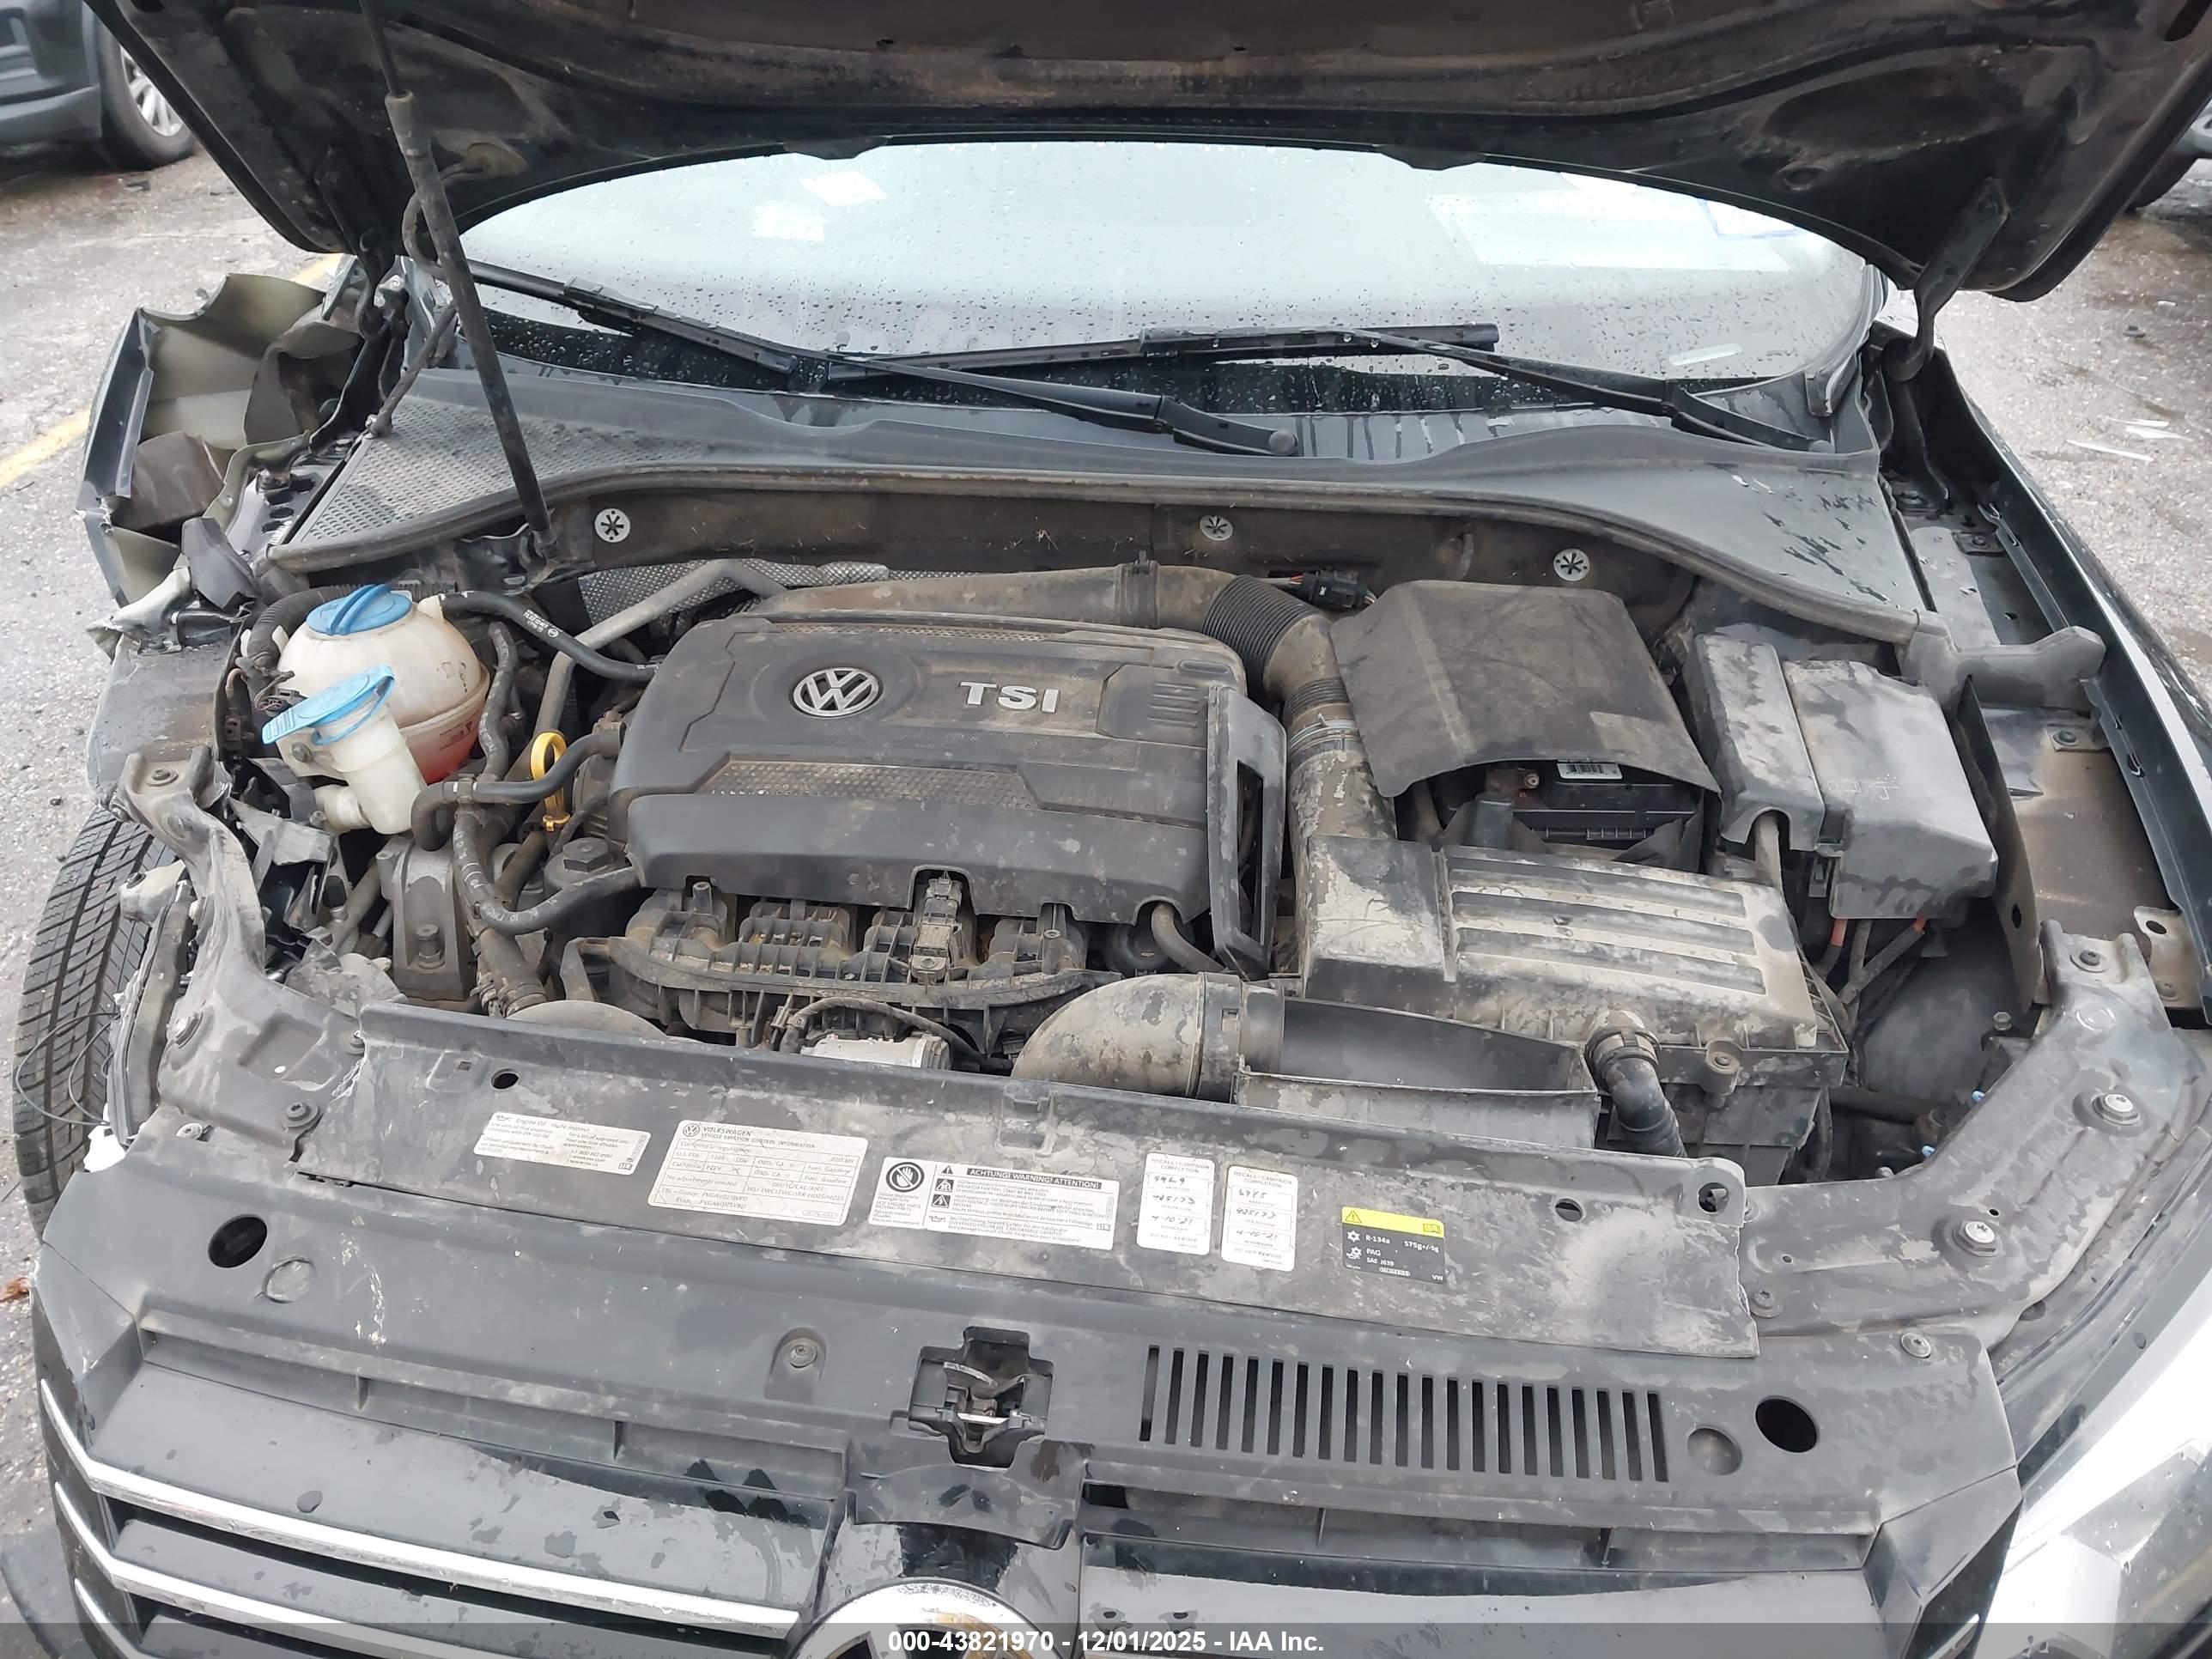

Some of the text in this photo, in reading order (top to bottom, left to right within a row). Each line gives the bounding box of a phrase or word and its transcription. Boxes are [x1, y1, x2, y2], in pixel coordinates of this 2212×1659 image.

[960, 682, 1058, 713] TSI
[703, 1127, 751, 1137] VOLKSWAGEN
[777, 1140, 816, 1149] INFORMATION
[1161, 1165, 1200, 1174] COMPLETION
[970, 1169, 1011, 1178] ACHTUNG!
[1012, 1173, 1053, 1183] WARNING!
[1054, 1178, 1100, 1189] ATTENTION!
[1243, 1178, 1282, 1188] COMPLETION
[1365, 1234, 1390, 1244] R-134a
[1366, 1248, 1381, 1256] PAG
